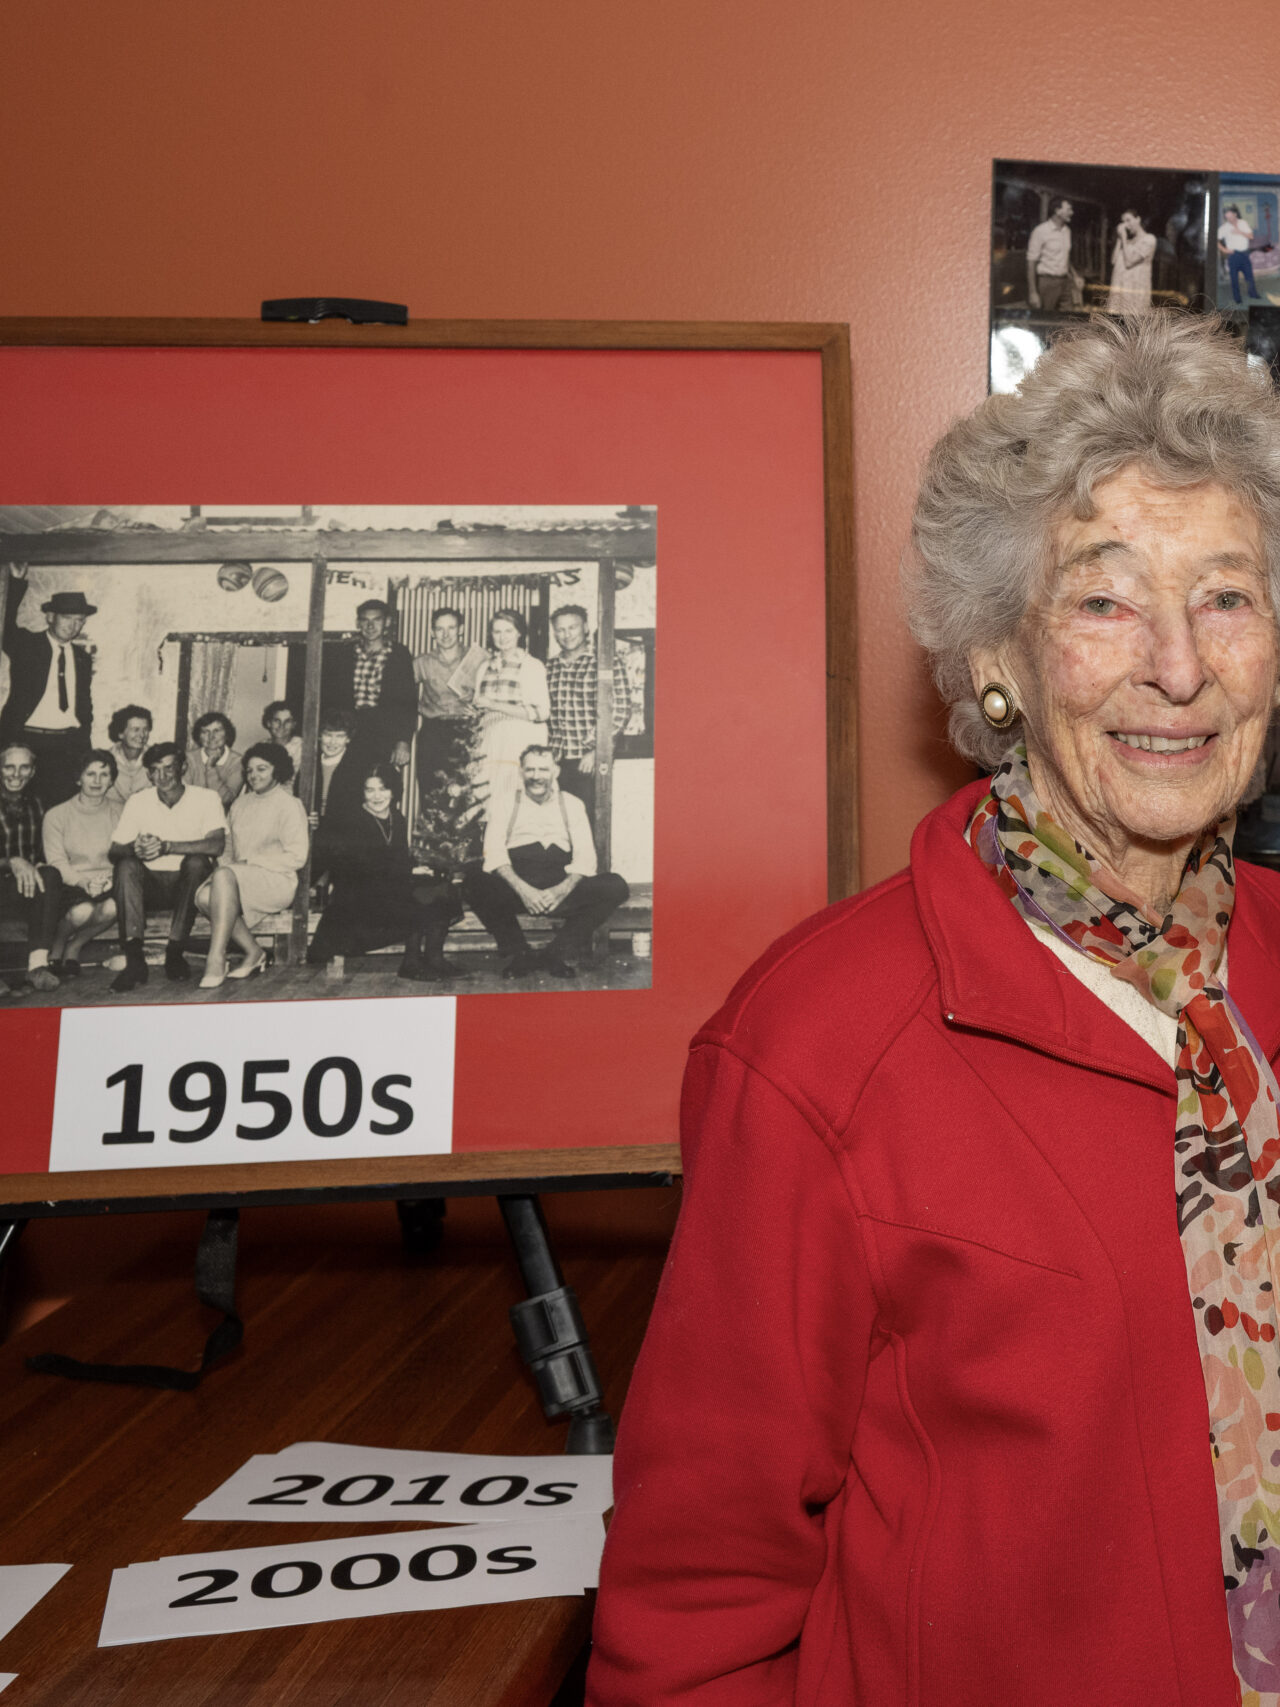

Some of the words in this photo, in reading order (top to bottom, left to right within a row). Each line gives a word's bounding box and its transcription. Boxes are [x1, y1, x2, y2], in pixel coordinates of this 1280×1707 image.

[102, 1056, 414, 1145] 1950s
[248, 1475, 578, 1506] 2010s
[168, 1544, 537, 1608] 2000s
